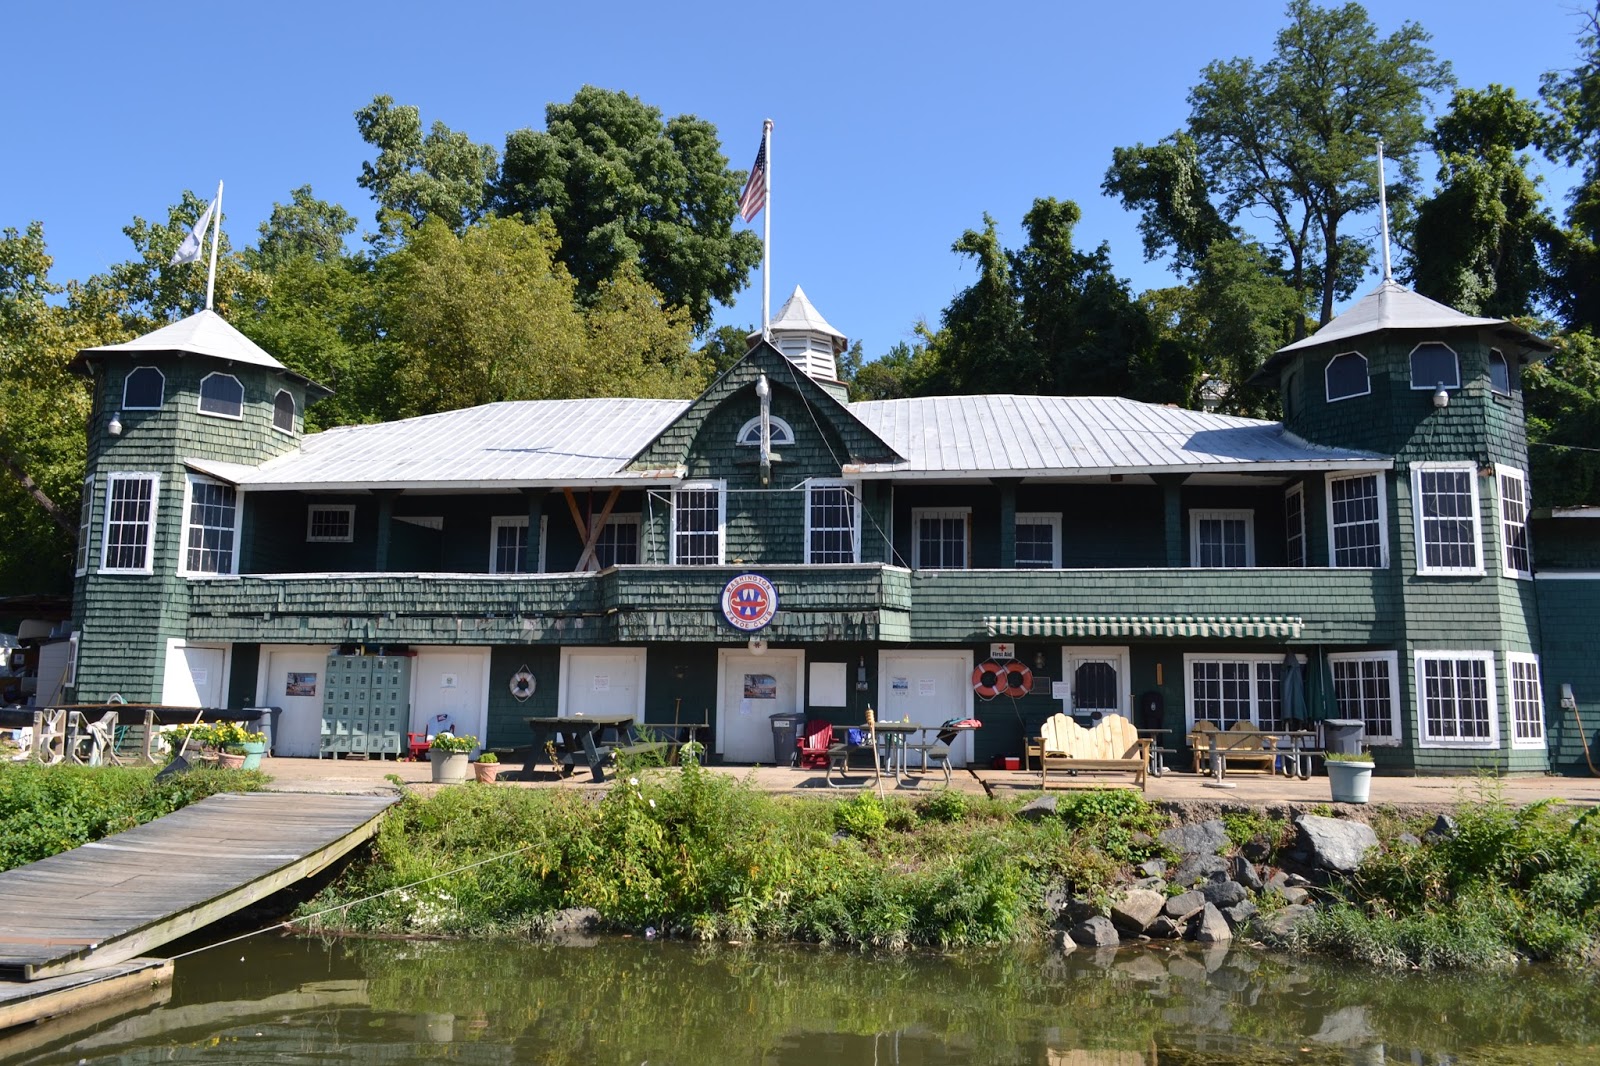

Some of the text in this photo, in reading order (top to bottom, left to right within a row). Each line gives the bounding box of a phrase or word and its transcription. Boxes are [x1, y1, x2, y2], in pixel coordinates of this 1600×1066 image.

[726, 576, 771, 593] WASHINGTON
[726, 610, 773, 628] CANOE CLUB
